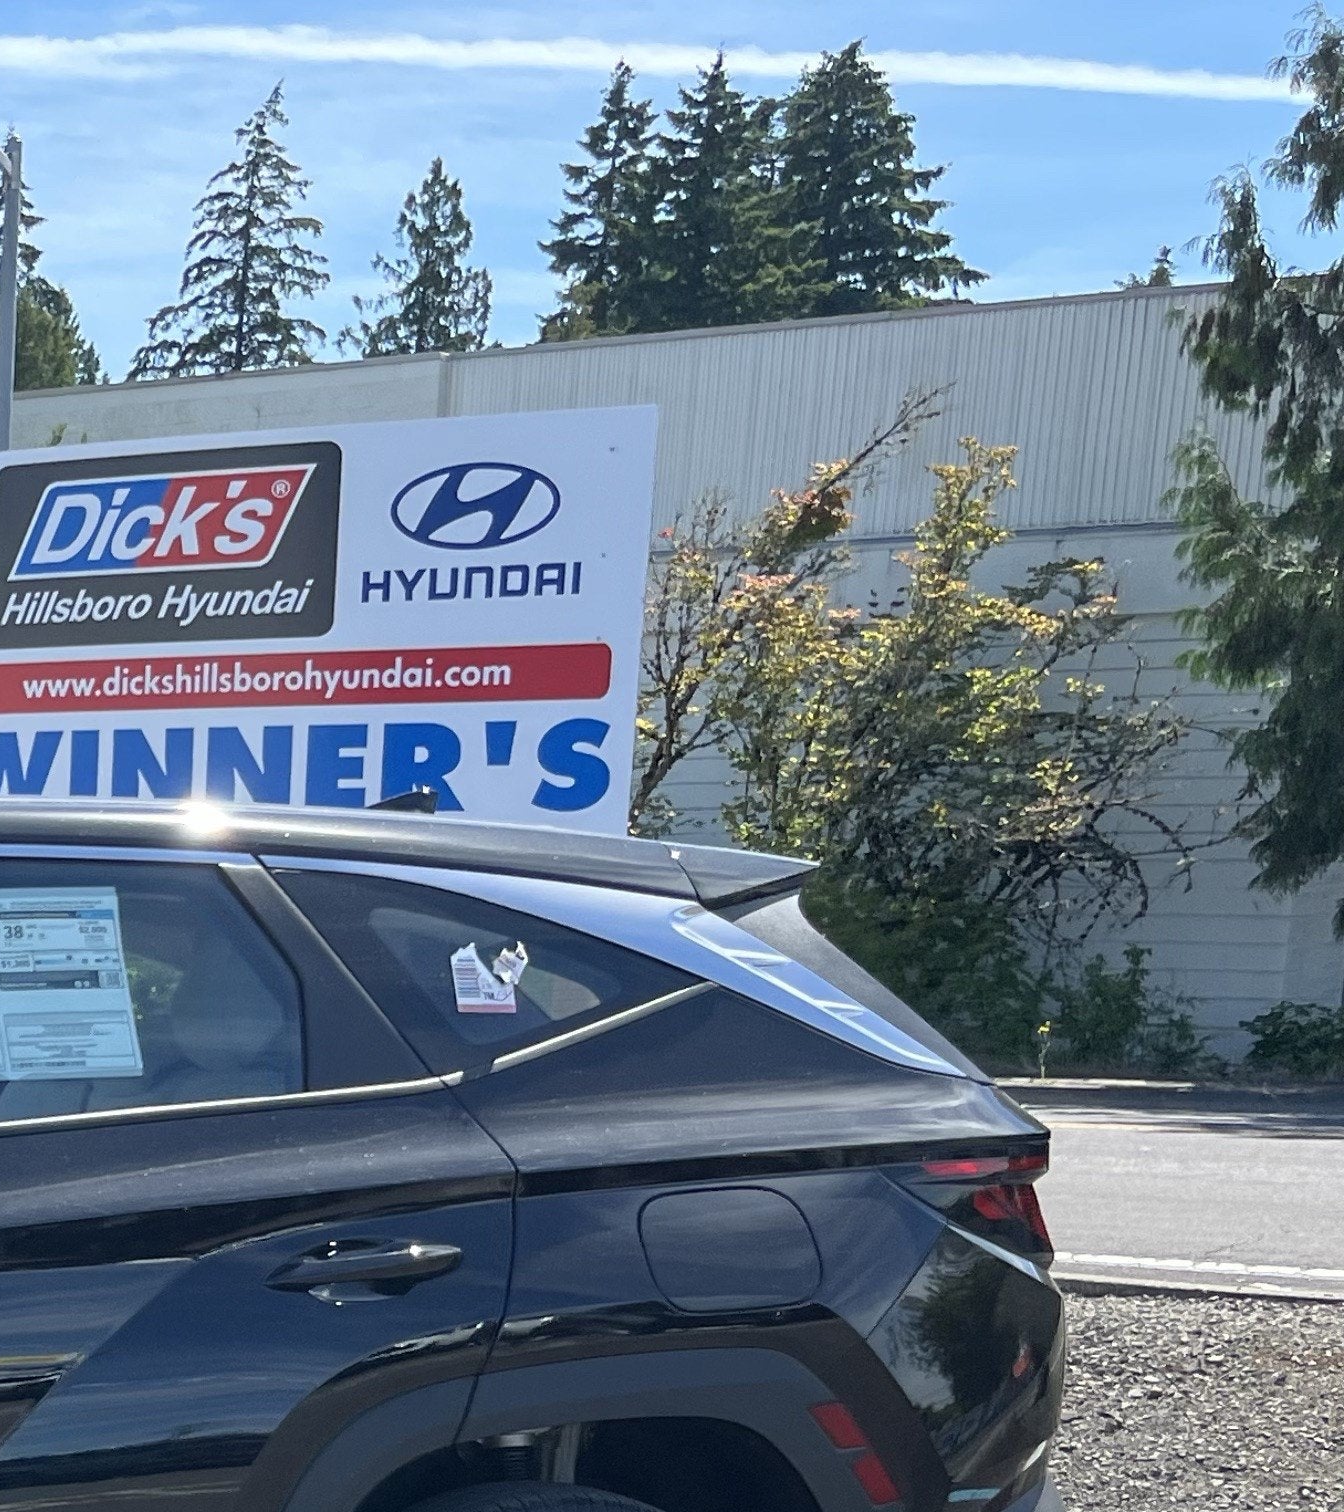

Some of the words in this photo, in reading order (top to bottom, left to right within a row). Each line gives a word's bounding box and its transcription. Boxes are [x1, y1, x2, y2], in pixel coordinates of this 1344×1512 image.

[0, 588, 153, 627] Hillsboro
[158, 578, 315, 627] Hyundai
[361, 561, 582, 603] HYUNDAI
[23, 660, 511, 700] www.dickshillsborohyundai.com
[3, 925, 24, 939] 38
